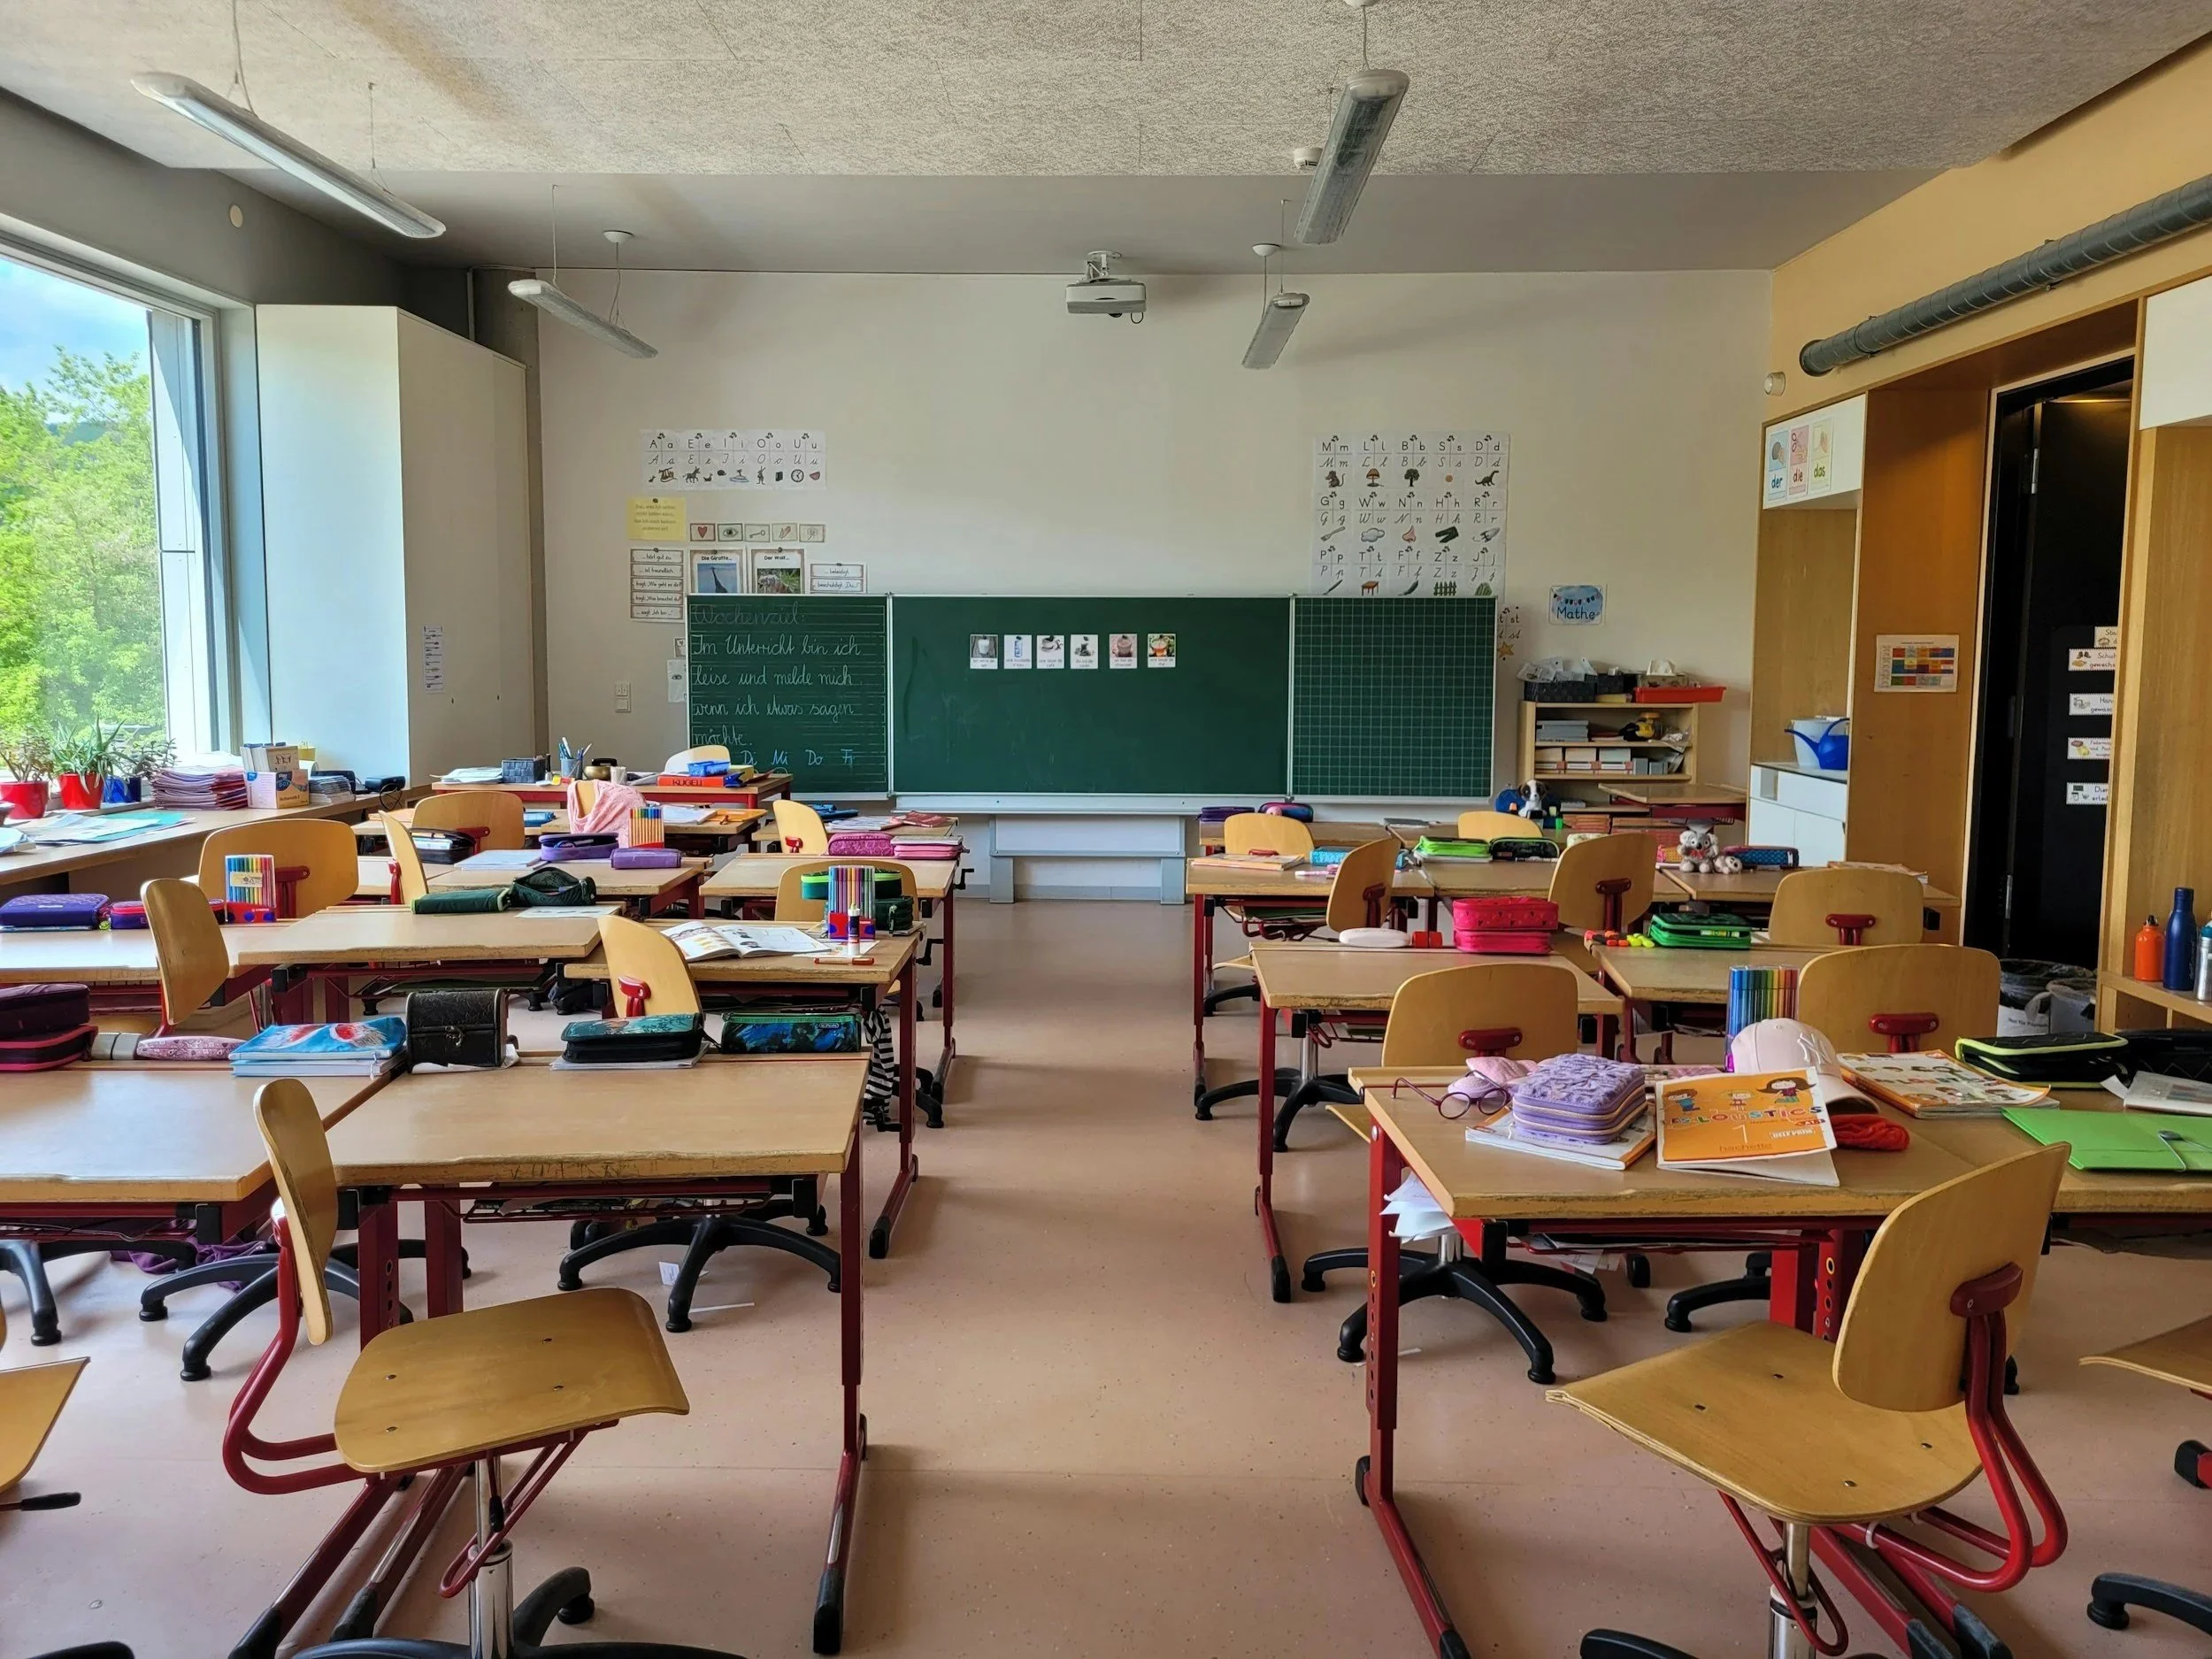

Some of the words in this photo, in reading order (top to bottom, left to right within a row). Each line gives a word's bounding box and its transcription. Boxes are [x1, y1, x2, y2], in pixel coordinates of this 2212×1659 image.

[649, 440, 657, 449] A
[687, 439, 694, 449] E
[757, 438, 766, 449] O
[794, 439, 801, 449] U
[1322, 442, 1331, 451] M
[1363, 442, 1370, 451] L
[1402, 442, 1409, 450] B
[1419, 442, 1425, 450] b
[1439, 442, 1446, 451] S
[1476, 441, 1483, 451] D
[1494, 442, 1500, 451] d
[1793, 469, 1803, 482] die
[1814, 463, 1825, 478] das
[1770, 474, 1783, 488] der
[1320, 496, 1329, 506] G
[1339, 500, 1345, 510] g
[1359, 498, 1371, 507] W
[1399, 498, 1406, 507] N
[1436, 498, 1443, 508] H
[1455, 498, 1460, 508] h
[1475, 497, 1480, 507] R
[1320, 550, 1326, 559] P
[1337, 554, 1343, 565] p
[1359, 552, 1366, 562] T
[1378, 552, 1382, 562] t
[1398, 550, 1403, 560] F
[1416, 550, 1421, 560] f
[1434, 552, 1442, 562] Z
[1472, 552, 1479, 562] J
[1556, 606, 1596, 620] Mathe
[692, 634, 718, 656] Im
[726, 634, 795, 656] Unterricht
[801, 634, 828, 656] bin
[833, 634, 861, 656] ich
[694, 664, 731, 686] leise
[738, 665, 767, 686] und
[773, 664, 813, 686] melde
[693, 703, 729, 716] wenn
[734, 695, 759, 716] ich
[766, 695, 803, 716] etwas
[808, 703, 855, 723] sagen
[740, 750, 757, 765] Di
[770, 749, 788, 765] Mi
[805, 749, 824, 765] Do
[1732, 1124, 1748, 1144] 1
